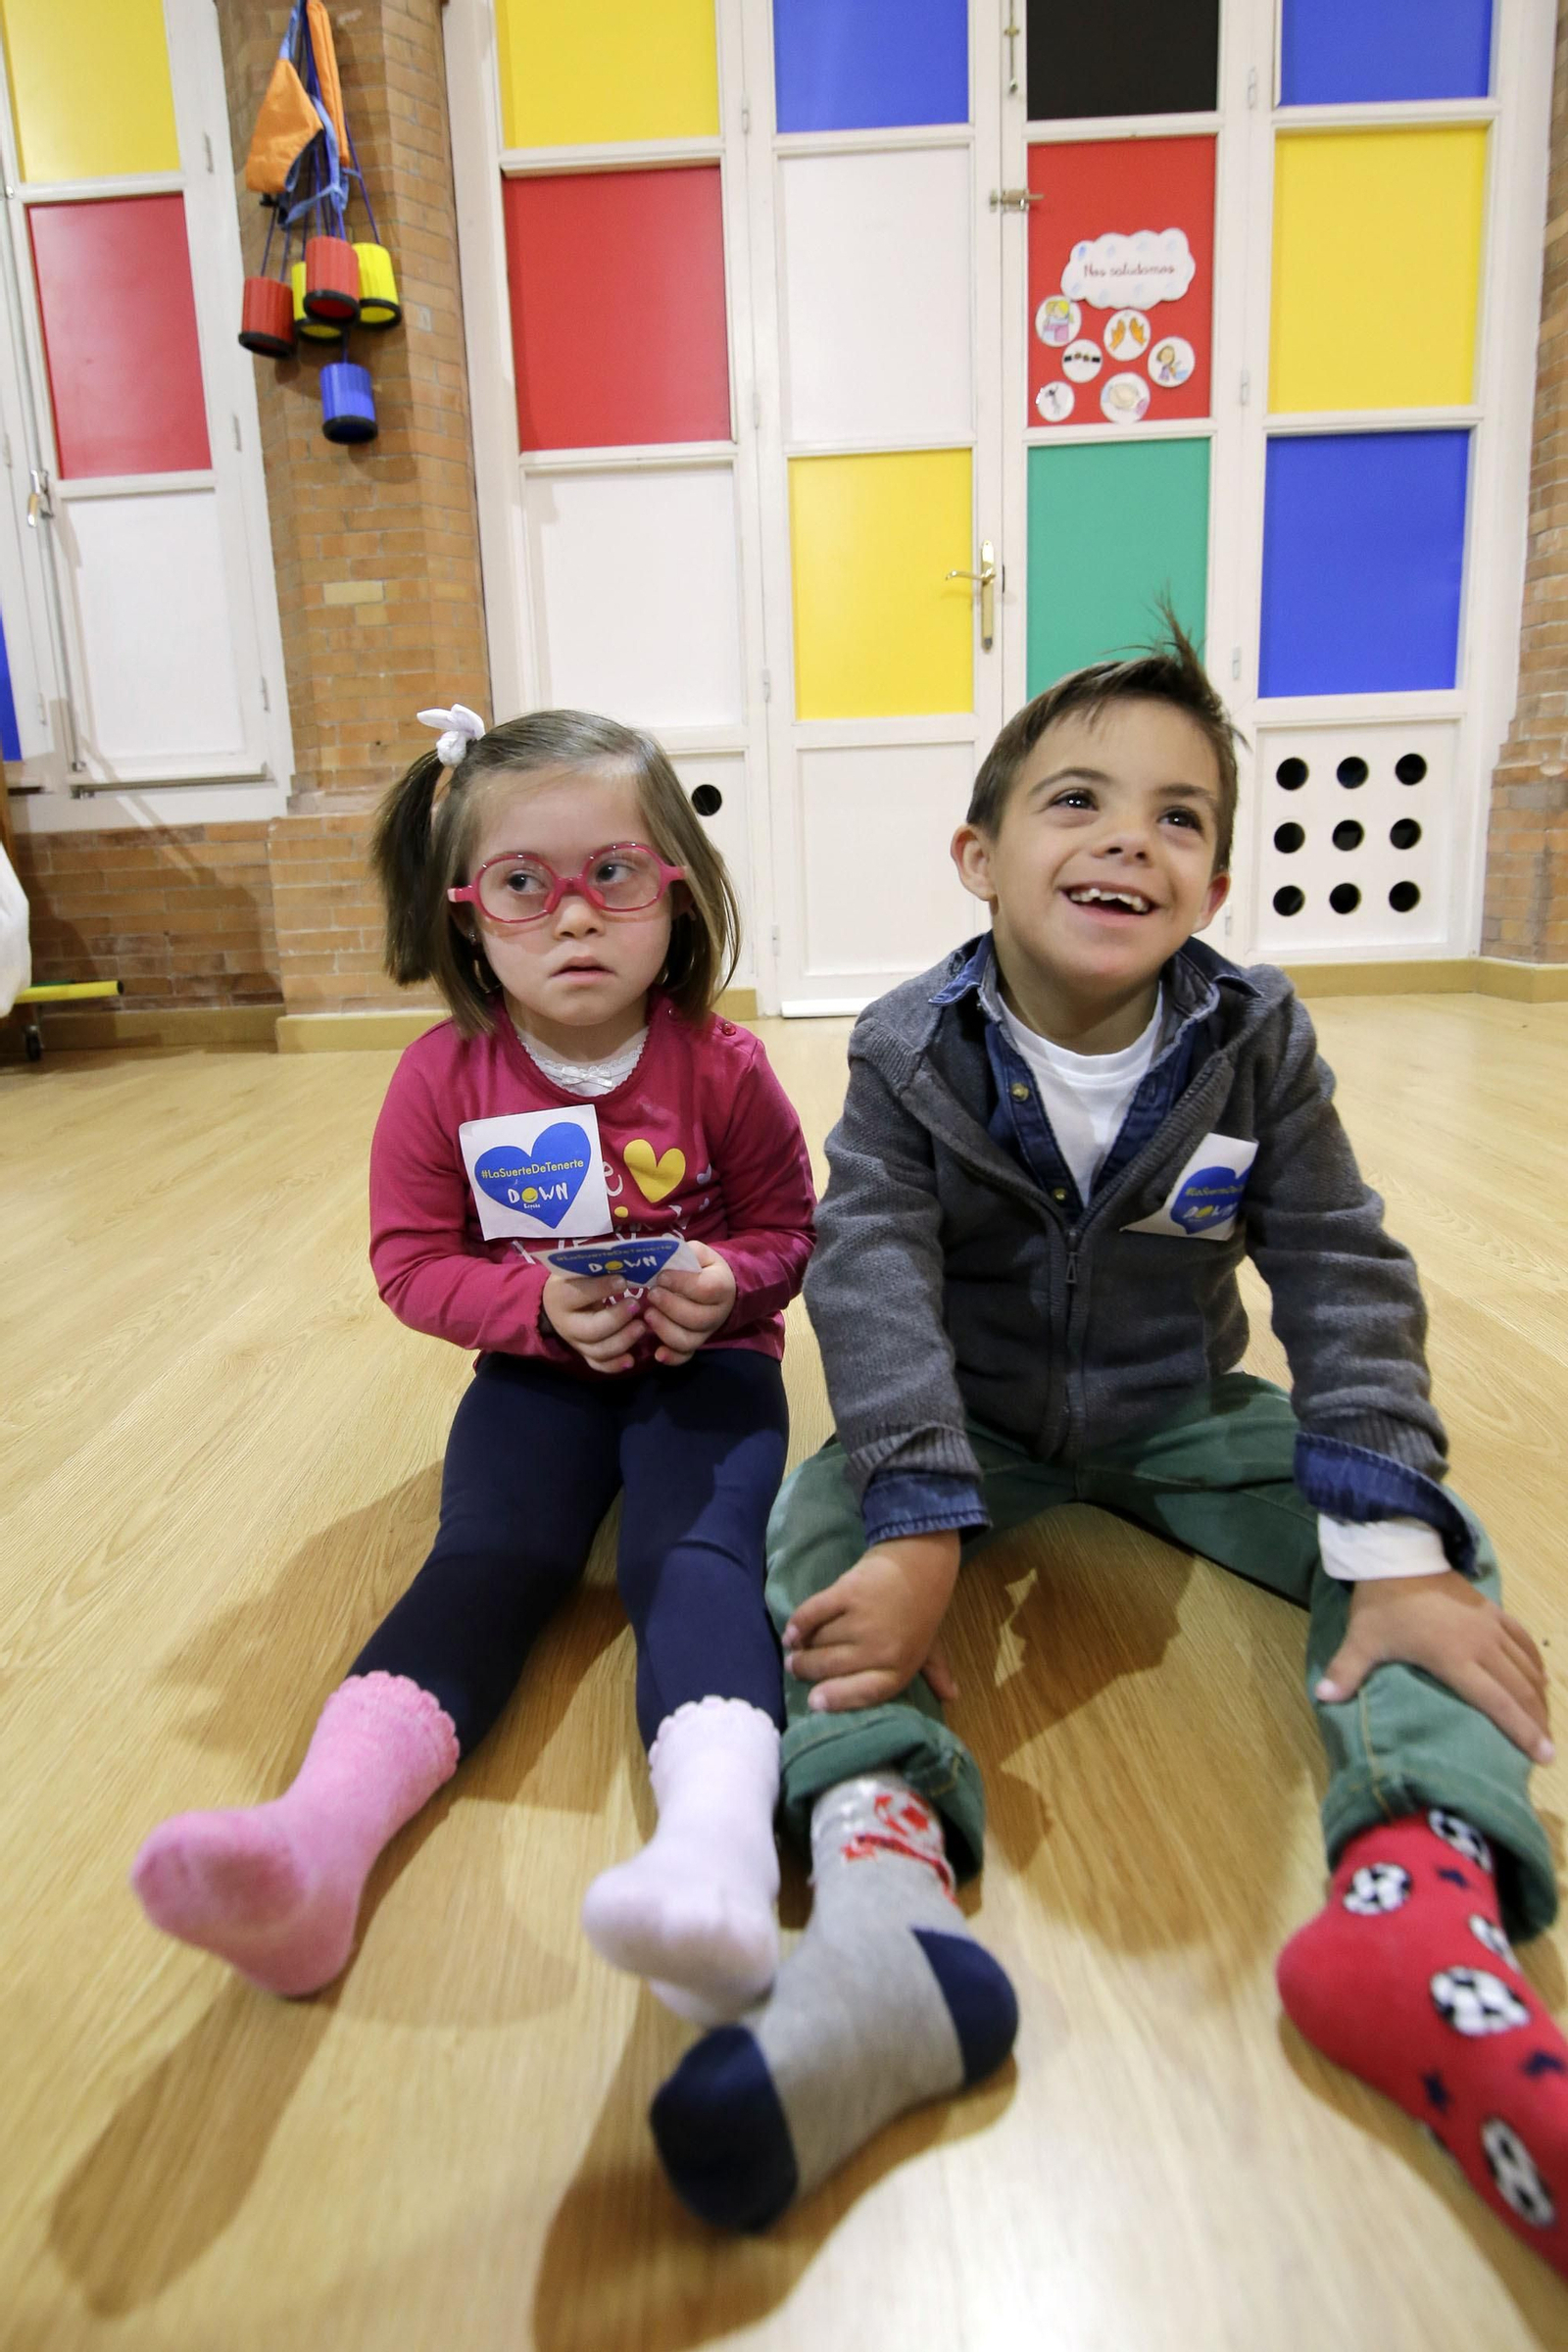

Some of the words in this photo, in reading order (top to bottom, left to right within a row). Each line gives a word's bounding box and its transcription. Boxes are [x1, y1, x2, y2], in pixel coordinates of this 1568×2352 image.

[480, 1159, 585, 1179] #LaSuerteDeTenerte
[507, 1182, 568, 1204] DOWN
[588, 1255, 658, 1273] DOWN
